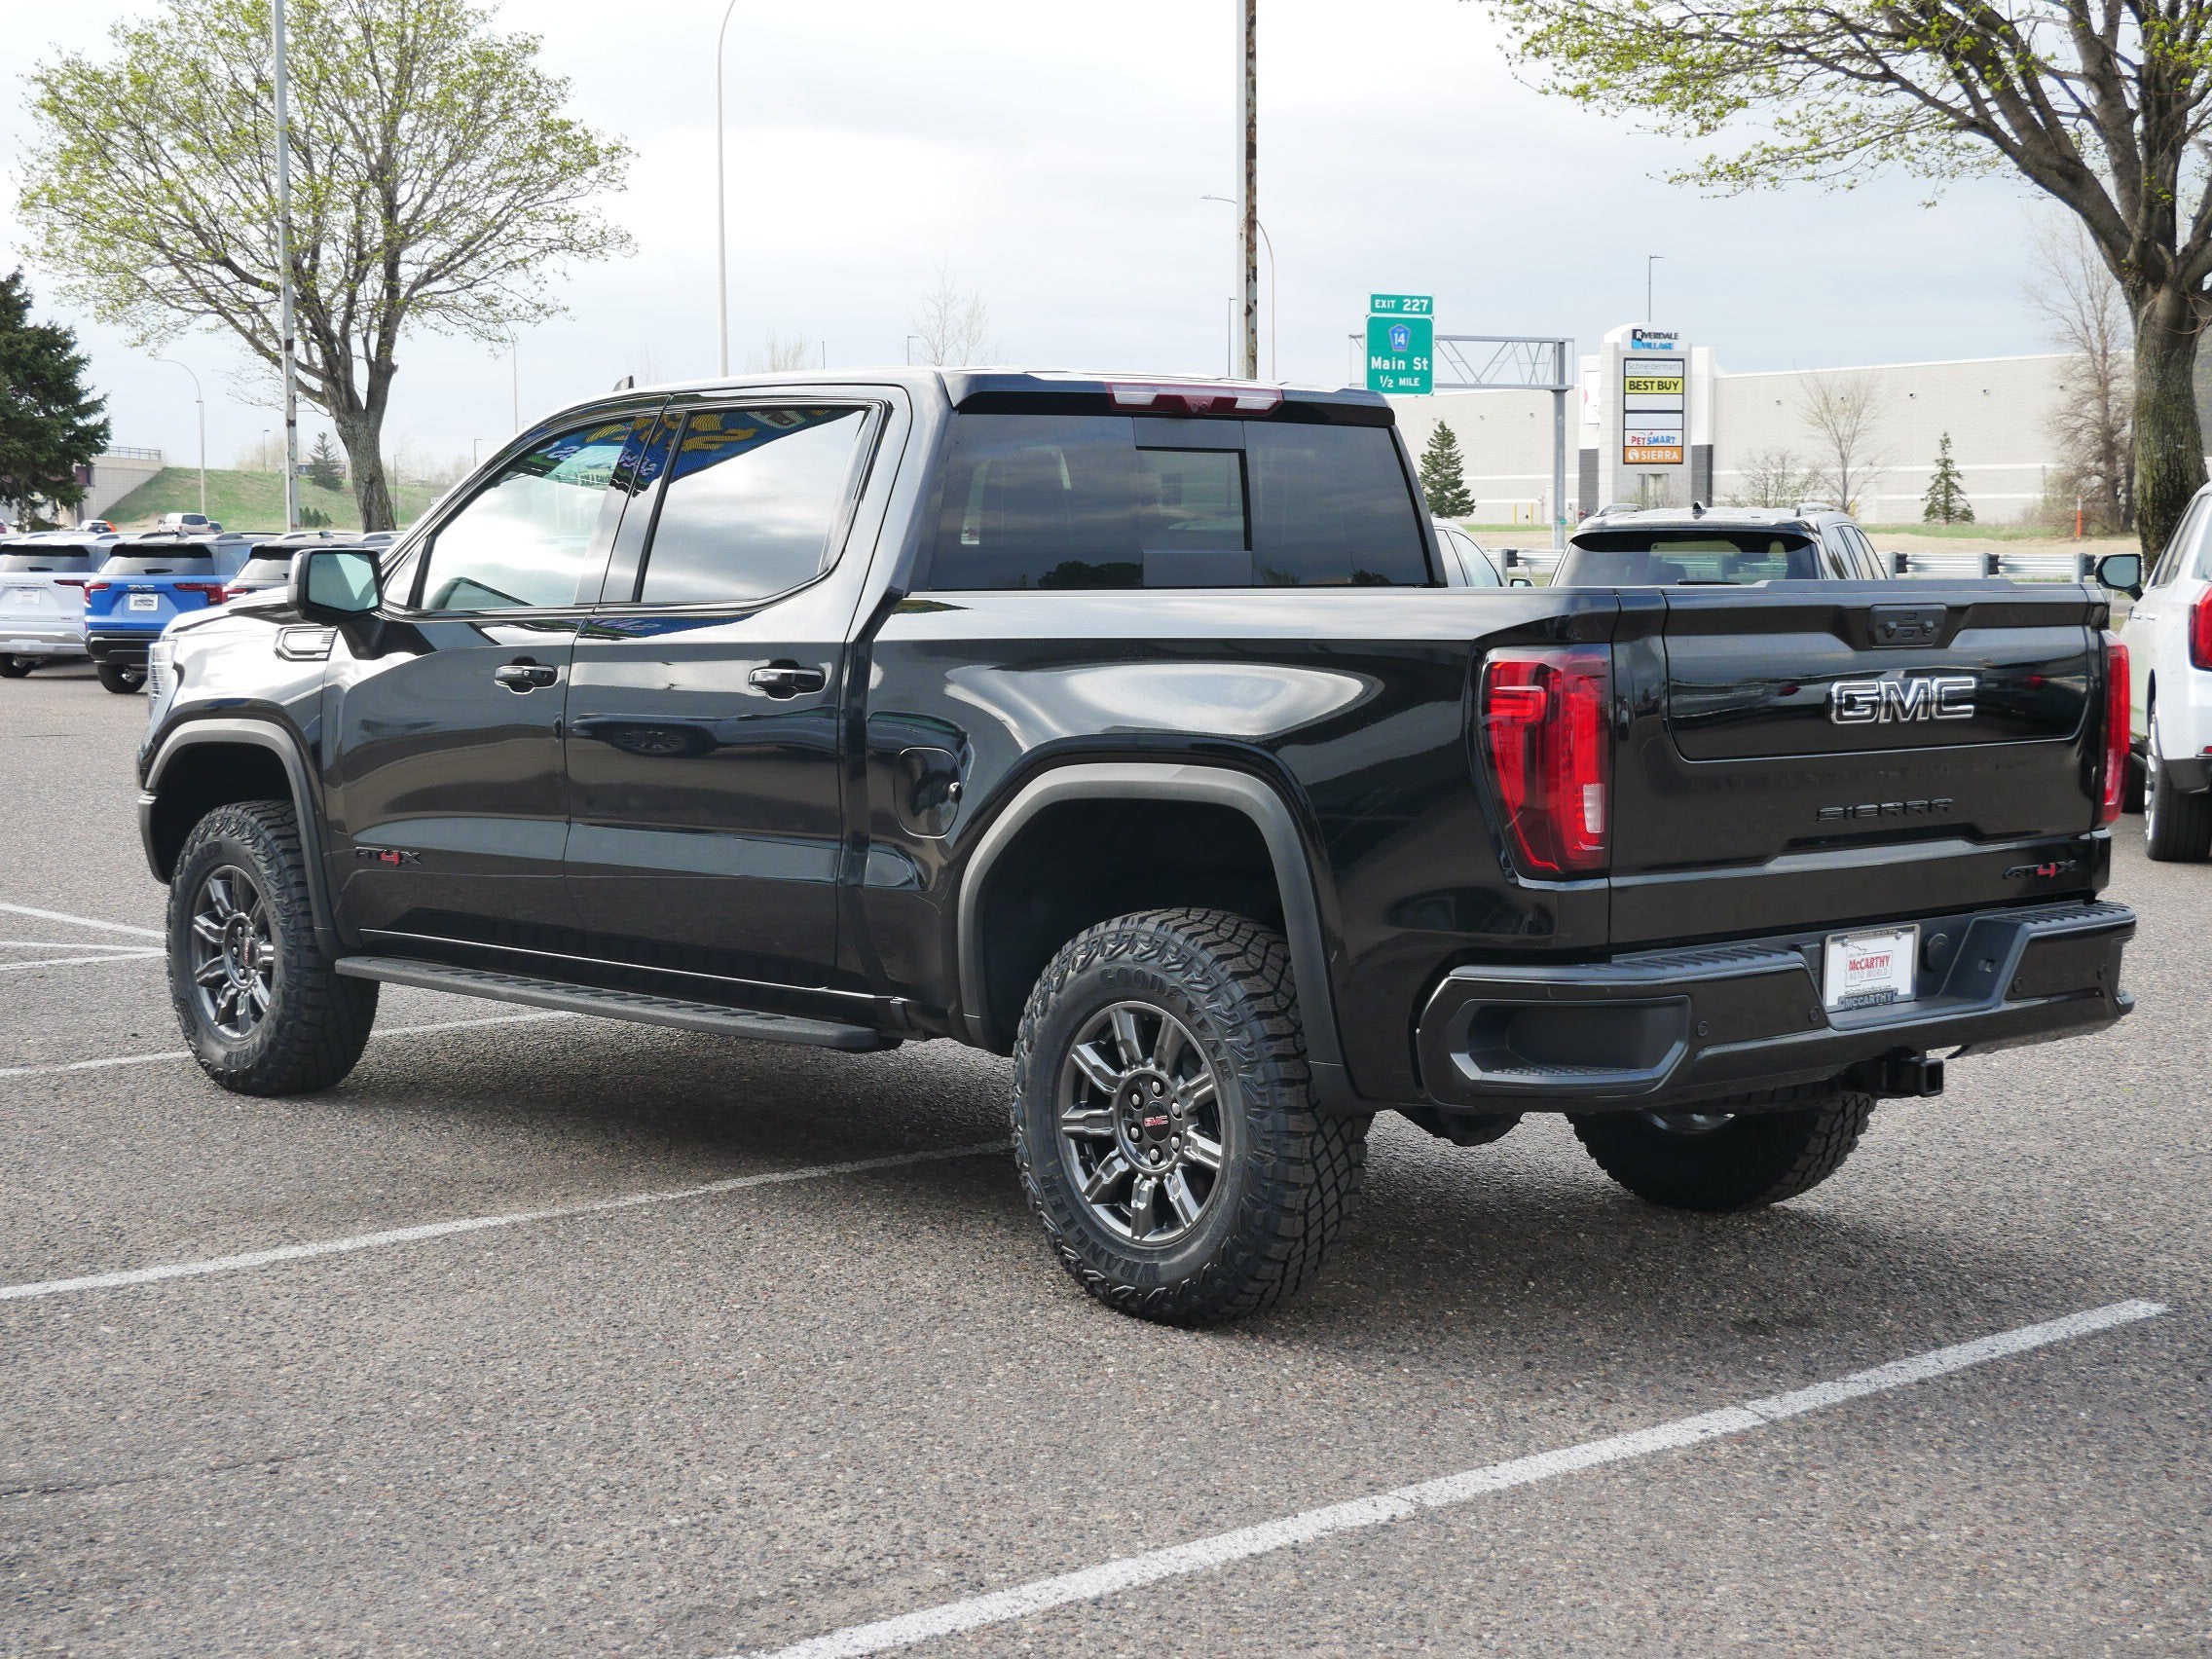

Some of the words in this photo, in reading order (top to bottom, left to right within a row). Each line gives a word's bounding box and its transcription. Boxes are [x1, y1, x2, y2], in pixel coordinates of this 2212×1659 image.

[1375, 300, 1396, 309] EXIT
[1402, 299, 1428, 312] 227
[1394, 333, 1405, 345] 14
[1371, 356, 1405, 370] Main
[1413, 357, 1428, 370] St
[1399, 378, 1419, 387] MILE
[1629, 381, 1655, 390] BEST
[1657, 381, 1679, 390] BUY
[1641, 450, 1678, 461] SIERRA
[1829, 677, 1977, 725] GMC
[1816, 797, 1954, 823] SIERRA
[2002, 859, 2078, 880] AT4X
[1143, 1115, 1169, 1127] GMC
[1041, 1174, 1161, 1283] WRANGLER
